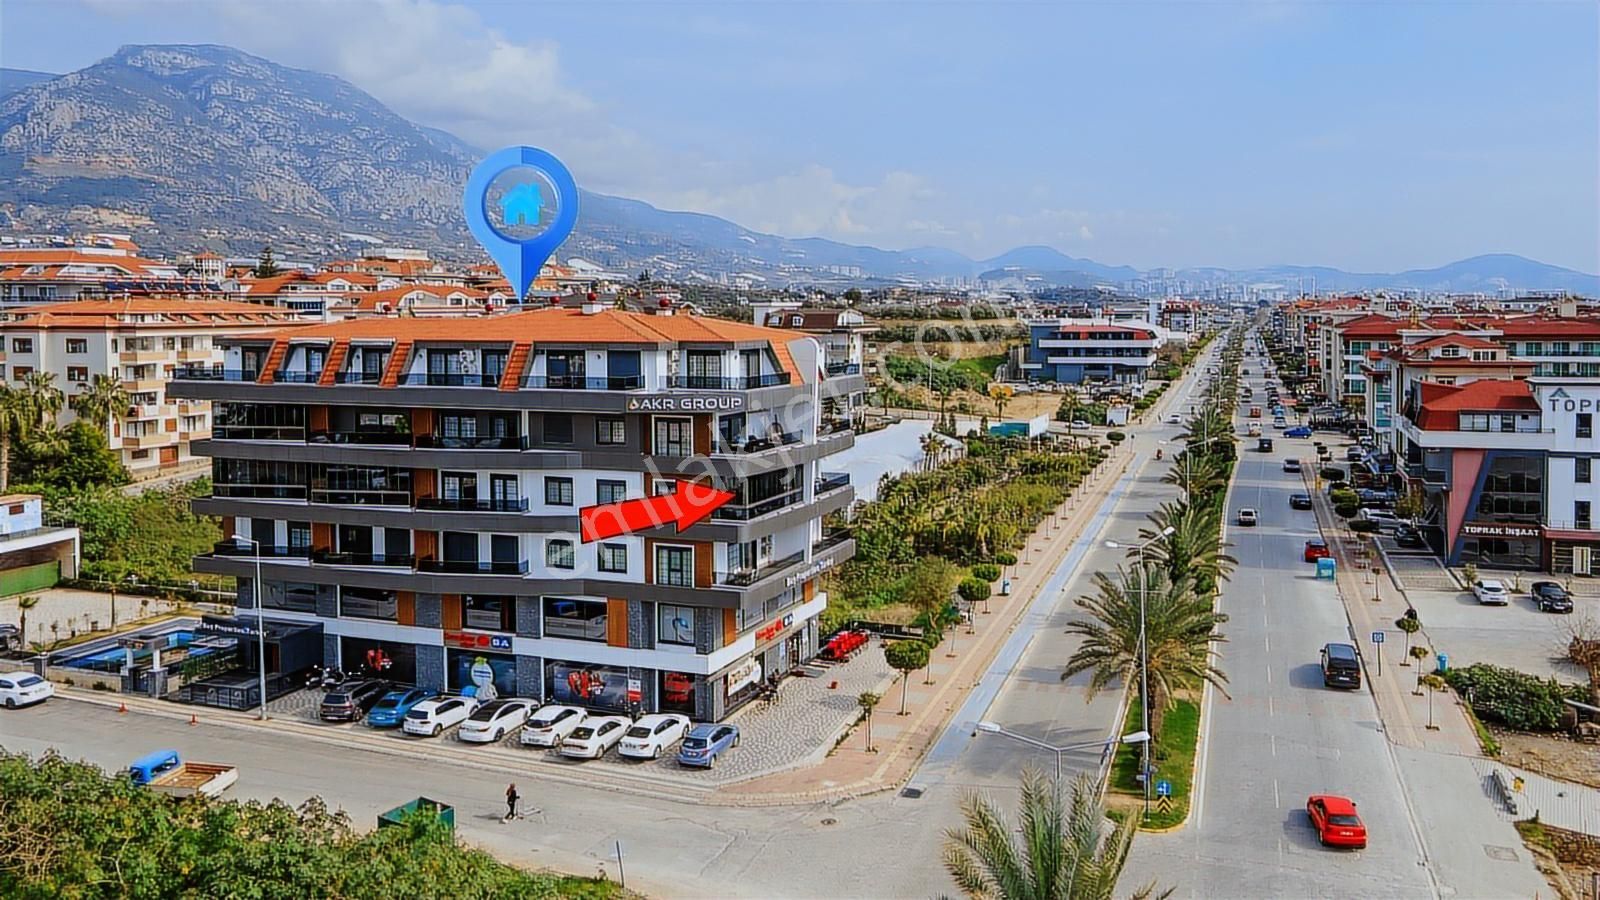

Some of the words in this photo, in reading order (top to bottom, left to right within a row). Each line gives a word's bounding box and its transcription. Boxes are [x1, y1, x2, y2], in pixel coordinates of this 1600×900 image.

[640, 398, 675, 410] AKR
[680, 397, 743, 410] GROUP
[1548, 398, 1600, 412] TOP
[1464, 526, 1503, 535] TOPRAK
